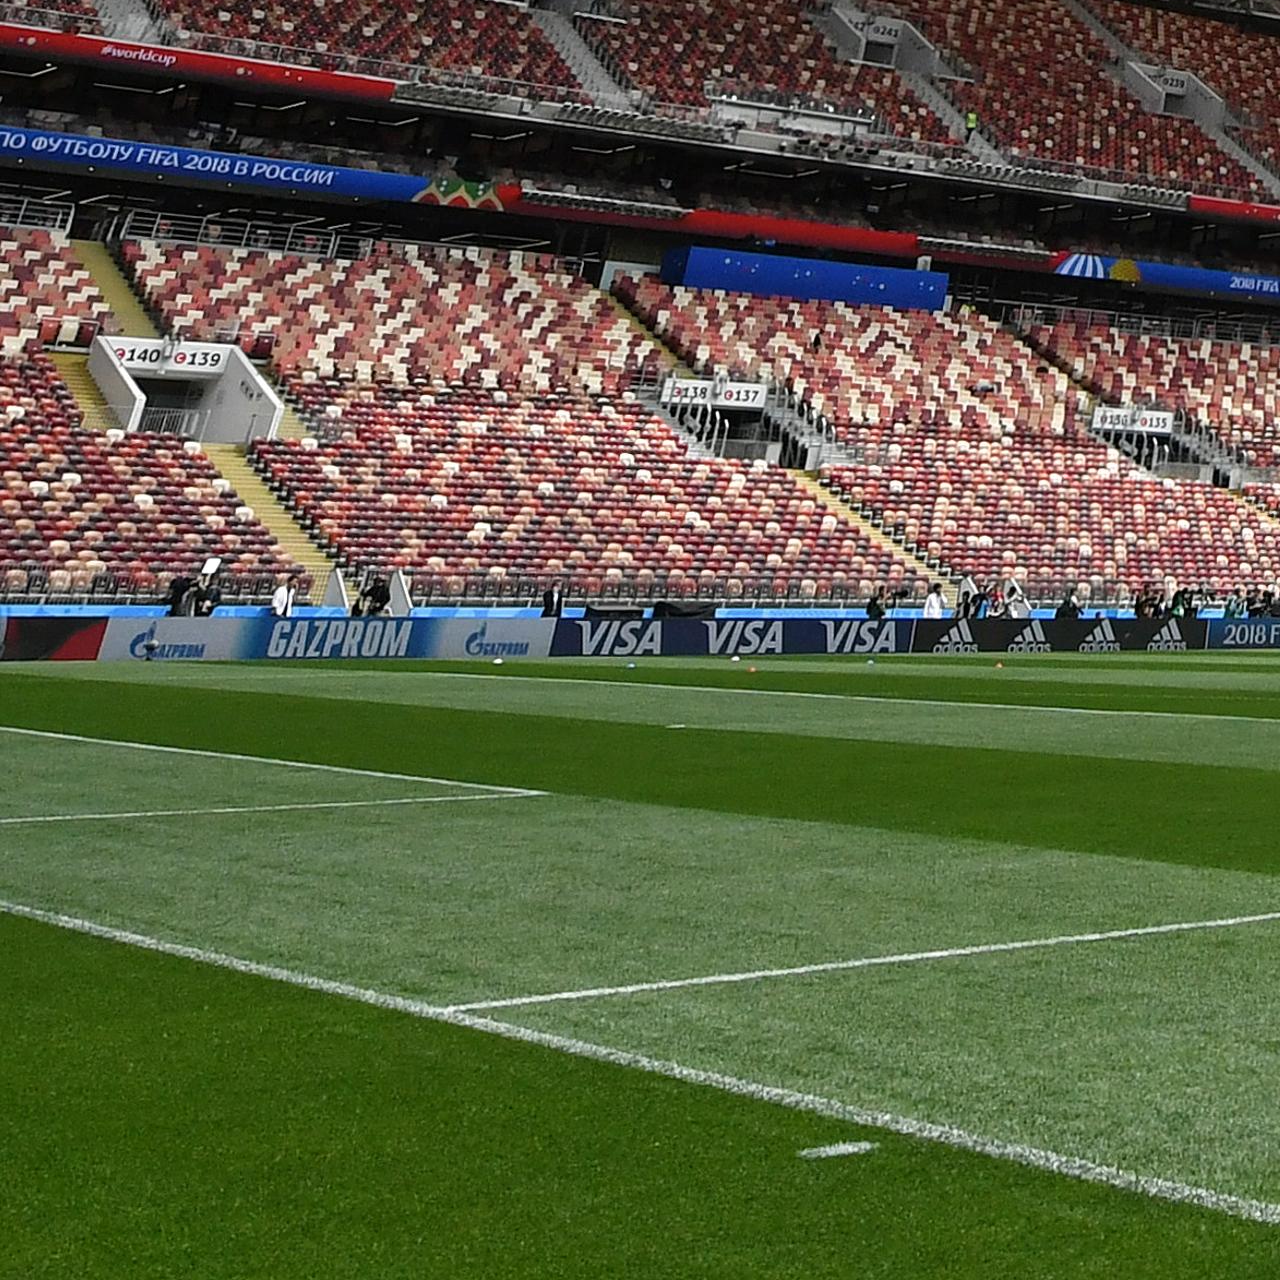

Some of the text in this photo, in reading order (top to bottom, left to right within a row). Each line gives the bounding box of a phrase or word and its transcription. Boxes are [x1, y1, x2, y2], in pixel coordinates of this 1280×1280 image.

[101, 45, 176, 67] #worldcup
[31, 136, 134, 161] ФУТБОЛУ
[136, 148, 179, 168] FIFA
[183, 155, 231, 174] 2018
[233, 160, 249, 175] В
[251, 163, 334, 186] РОССИИ
[1229, 276, 1256, 290] 2018
[1256, 279, 1279, 293] FIFA
[126, 349, 161, 363] 140
[188, 351, 221, 367] 139
[684, 386, 708, 399] 138
[735, 390, 760, 402] 137
[1149, 417, 1168, 428] 135
[267, 621, 414, 657] GAZPROM
[575, 621, 662, 655] VISA
[702, 621, 784, 654] VISA
[820, 621, 897, 653] VISA
[1223, 624, 1267, 644] 2018
[933, 640, 979, 653] adidas
[1008, 640, 1051, 653] adidas
[1078, 640, 1121, 653] adidas
[1147, 640, 1187, 652] adidas
